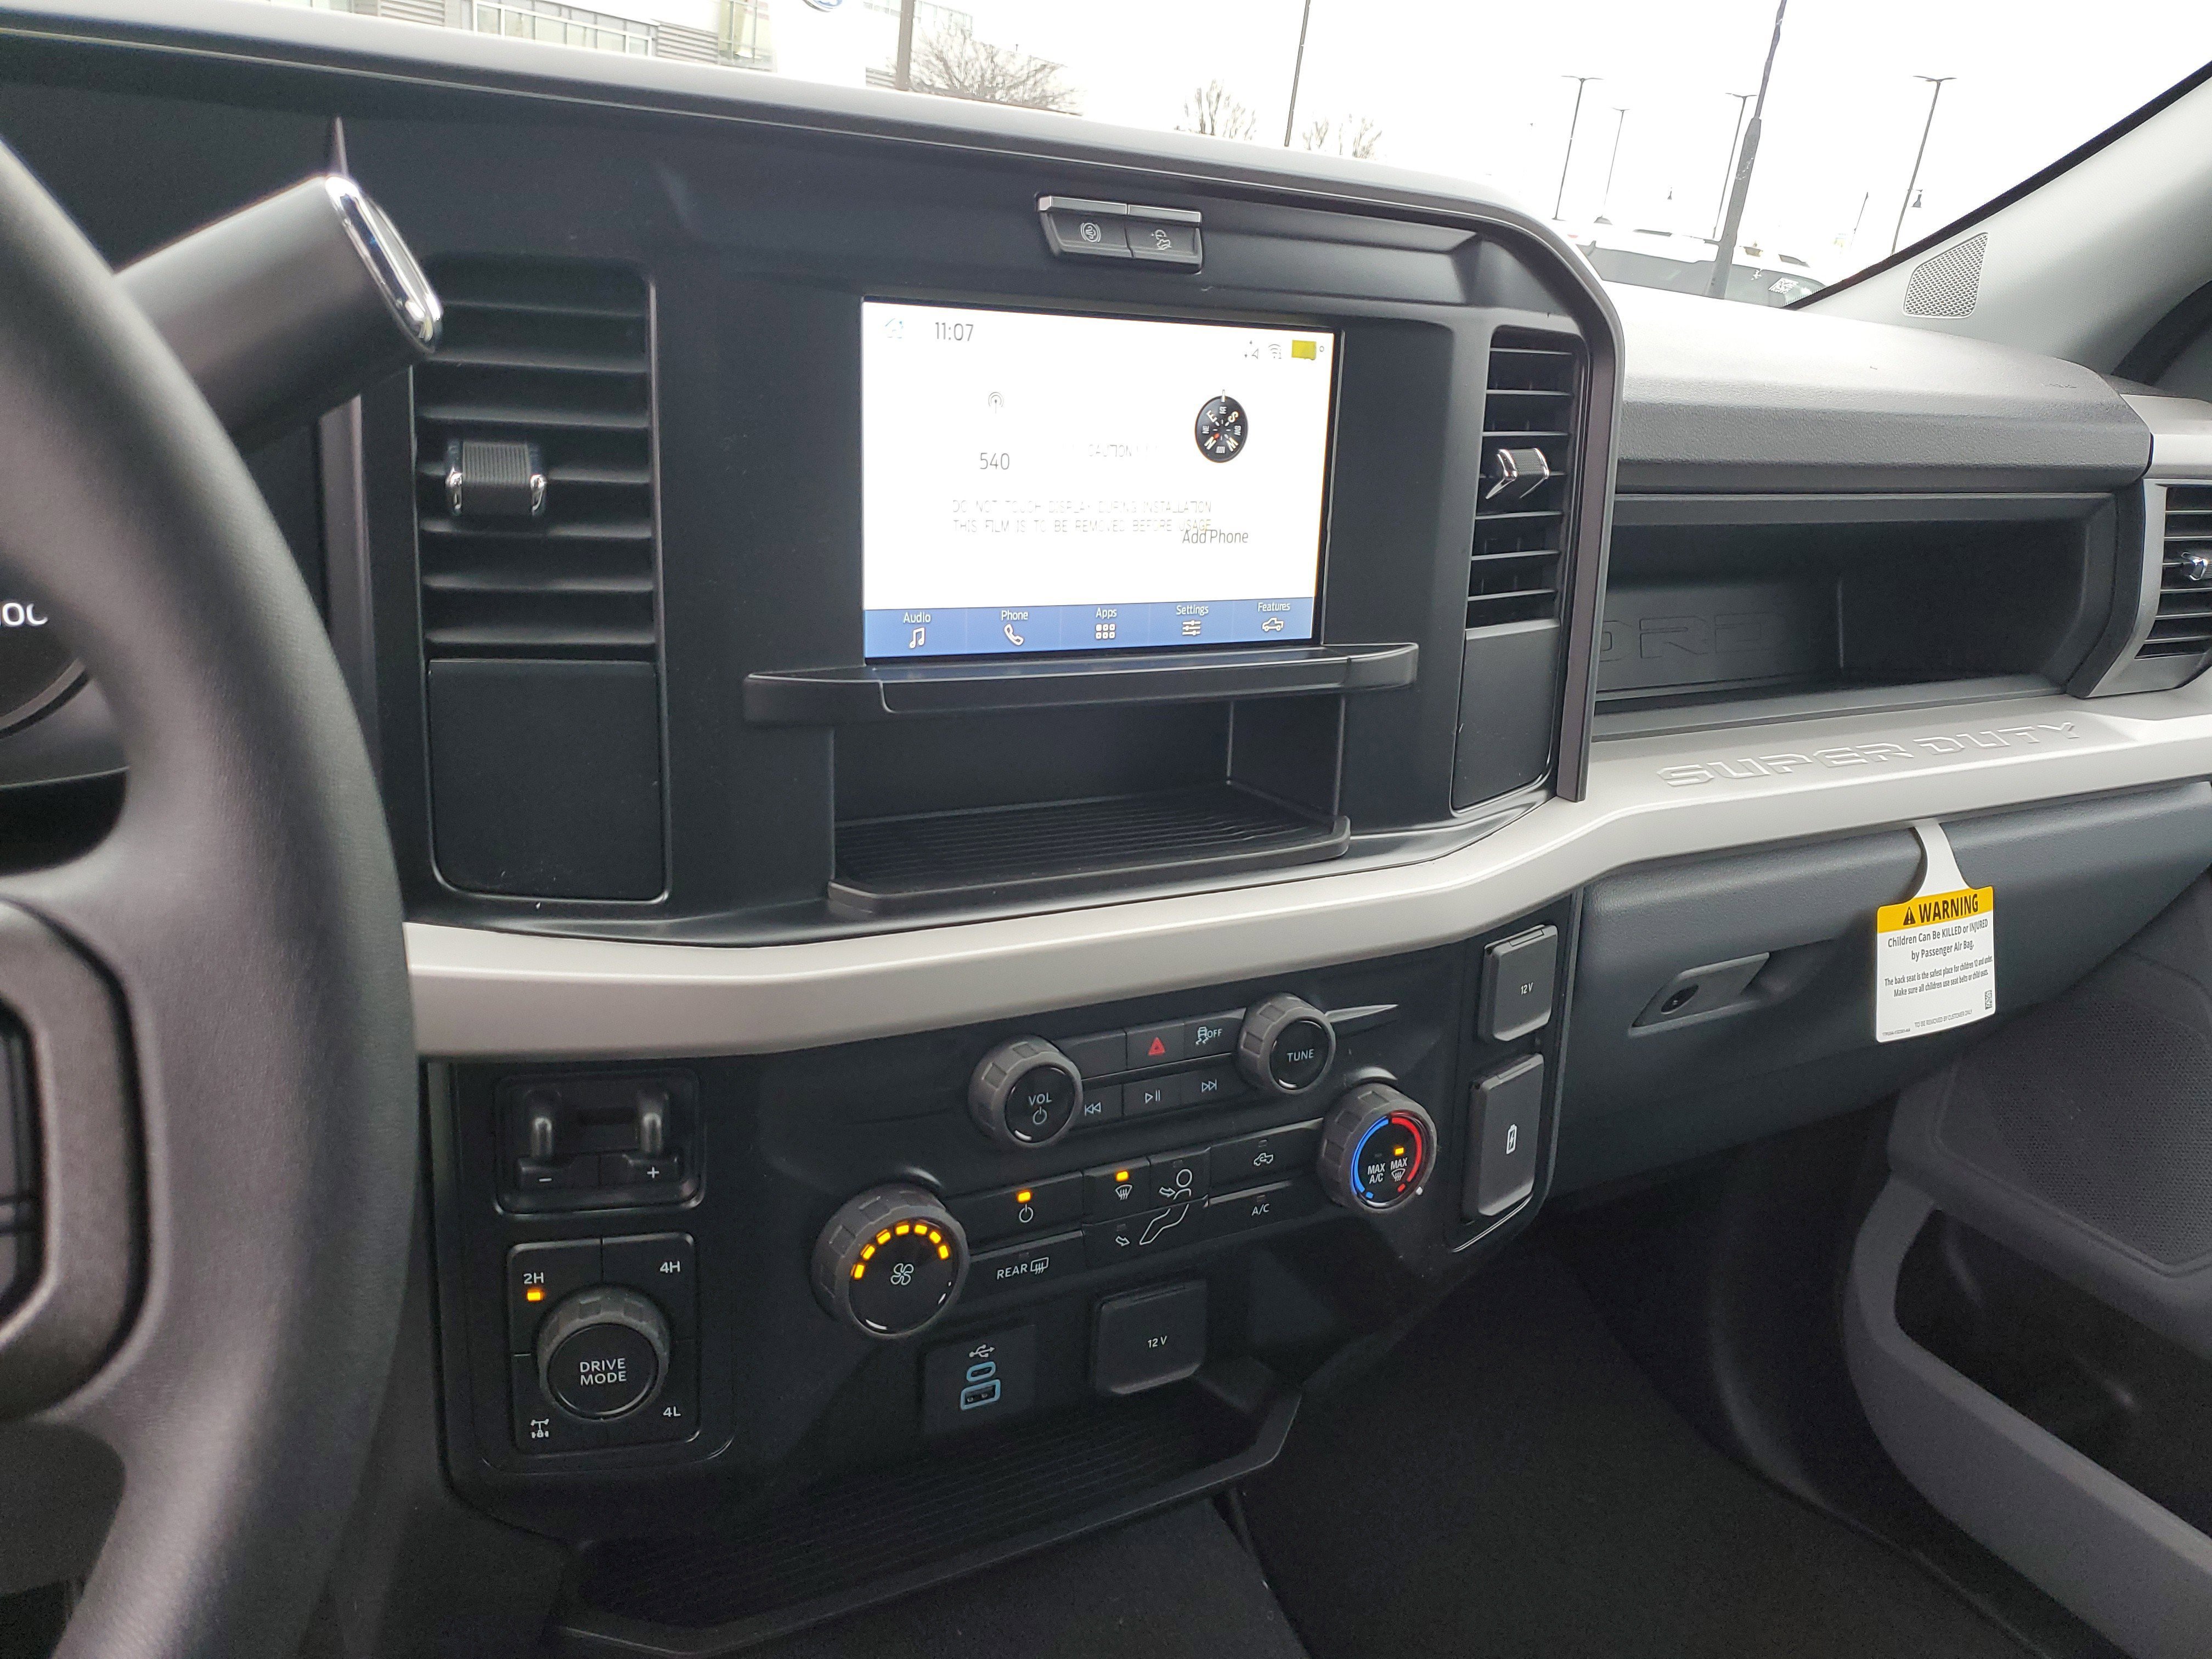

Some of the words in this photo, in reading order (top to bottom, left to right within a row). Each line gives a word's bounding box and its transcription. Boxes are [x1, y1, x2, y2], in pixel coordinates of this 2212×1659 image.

[935, 321, 974, 342] 11:07
[1228, 411, 1239, 423] S
[980, 452, 1010, 470] 540
[953, 520, 977, 533] THIS
[985, 520, 1009, 533] FILM
[1054, 520, 1068, 532] BE
[1182, 528, 1207, 544] Add
[1210, 529, 1248, 543] Phone
[1096, 607, 1118, 619] Apps
[1176, 604, 1209, 617] Settings
[1257, 601, 1290, 612] Features
[903, 611, 931, 624] Audio
[1001, 610, 1029, 621] Phone
[1657, 742, 1915, 787] SUPER
[1912, 721, 2081, 755] DUTY
[1918, 894, 1978, 923] WARNING
[1888, 935, 1917, 947] Children
[1918, 933, 1931, 942] Can
[1932, 930, 1940, 939] Be
[1942, 926, 1962, 938] KILLED
[1962, 925, 1968, 933] or
[1969, 918, 1988, 933] INJURED
[1911, 950, 1920, 962] by
[1921, 944, 1953, 959] Passenger
[1954, 941, 1962, 952] Air
[1884, 978, 1893, 986] The
[1894, 976, 1905, 985] back
[1906, 974, 1916, 983] seat
[1929, 968, 1942, 978] safest
[1943, 966, 1953, 978] place
[1521, 984, 1528, 996] 12
[1528, 982, 1533, 993] V
[1893, 988, 1907, 997] Make
[1207, 1028, 1223, 1039] OFF
[1286, 1048, 1314, 1063] TUNE
[1028, 1092, 1053, 1106] VOL
[1367, 1163, 1386, 1175] MAX
[1390, 1157, 1408, 1170] MAX
[1369, 1173, 1384, 1184] A/C
[1251, 1203, 1270, 1216] A/C
[659, 1261, 681, 1274] 4H
[997, 1263, 1028, 1280] REAR
[523, 1272, 545, 1285] 2H
[1147, 1338, 1159, 1348] 12
[1159, 1335, 1167, 1346] V
[579, 1358, 626, 1373] DRIVE
[580, 1370, 627, 1386] MODE
[663, 1406, 682, 1419] 4L
